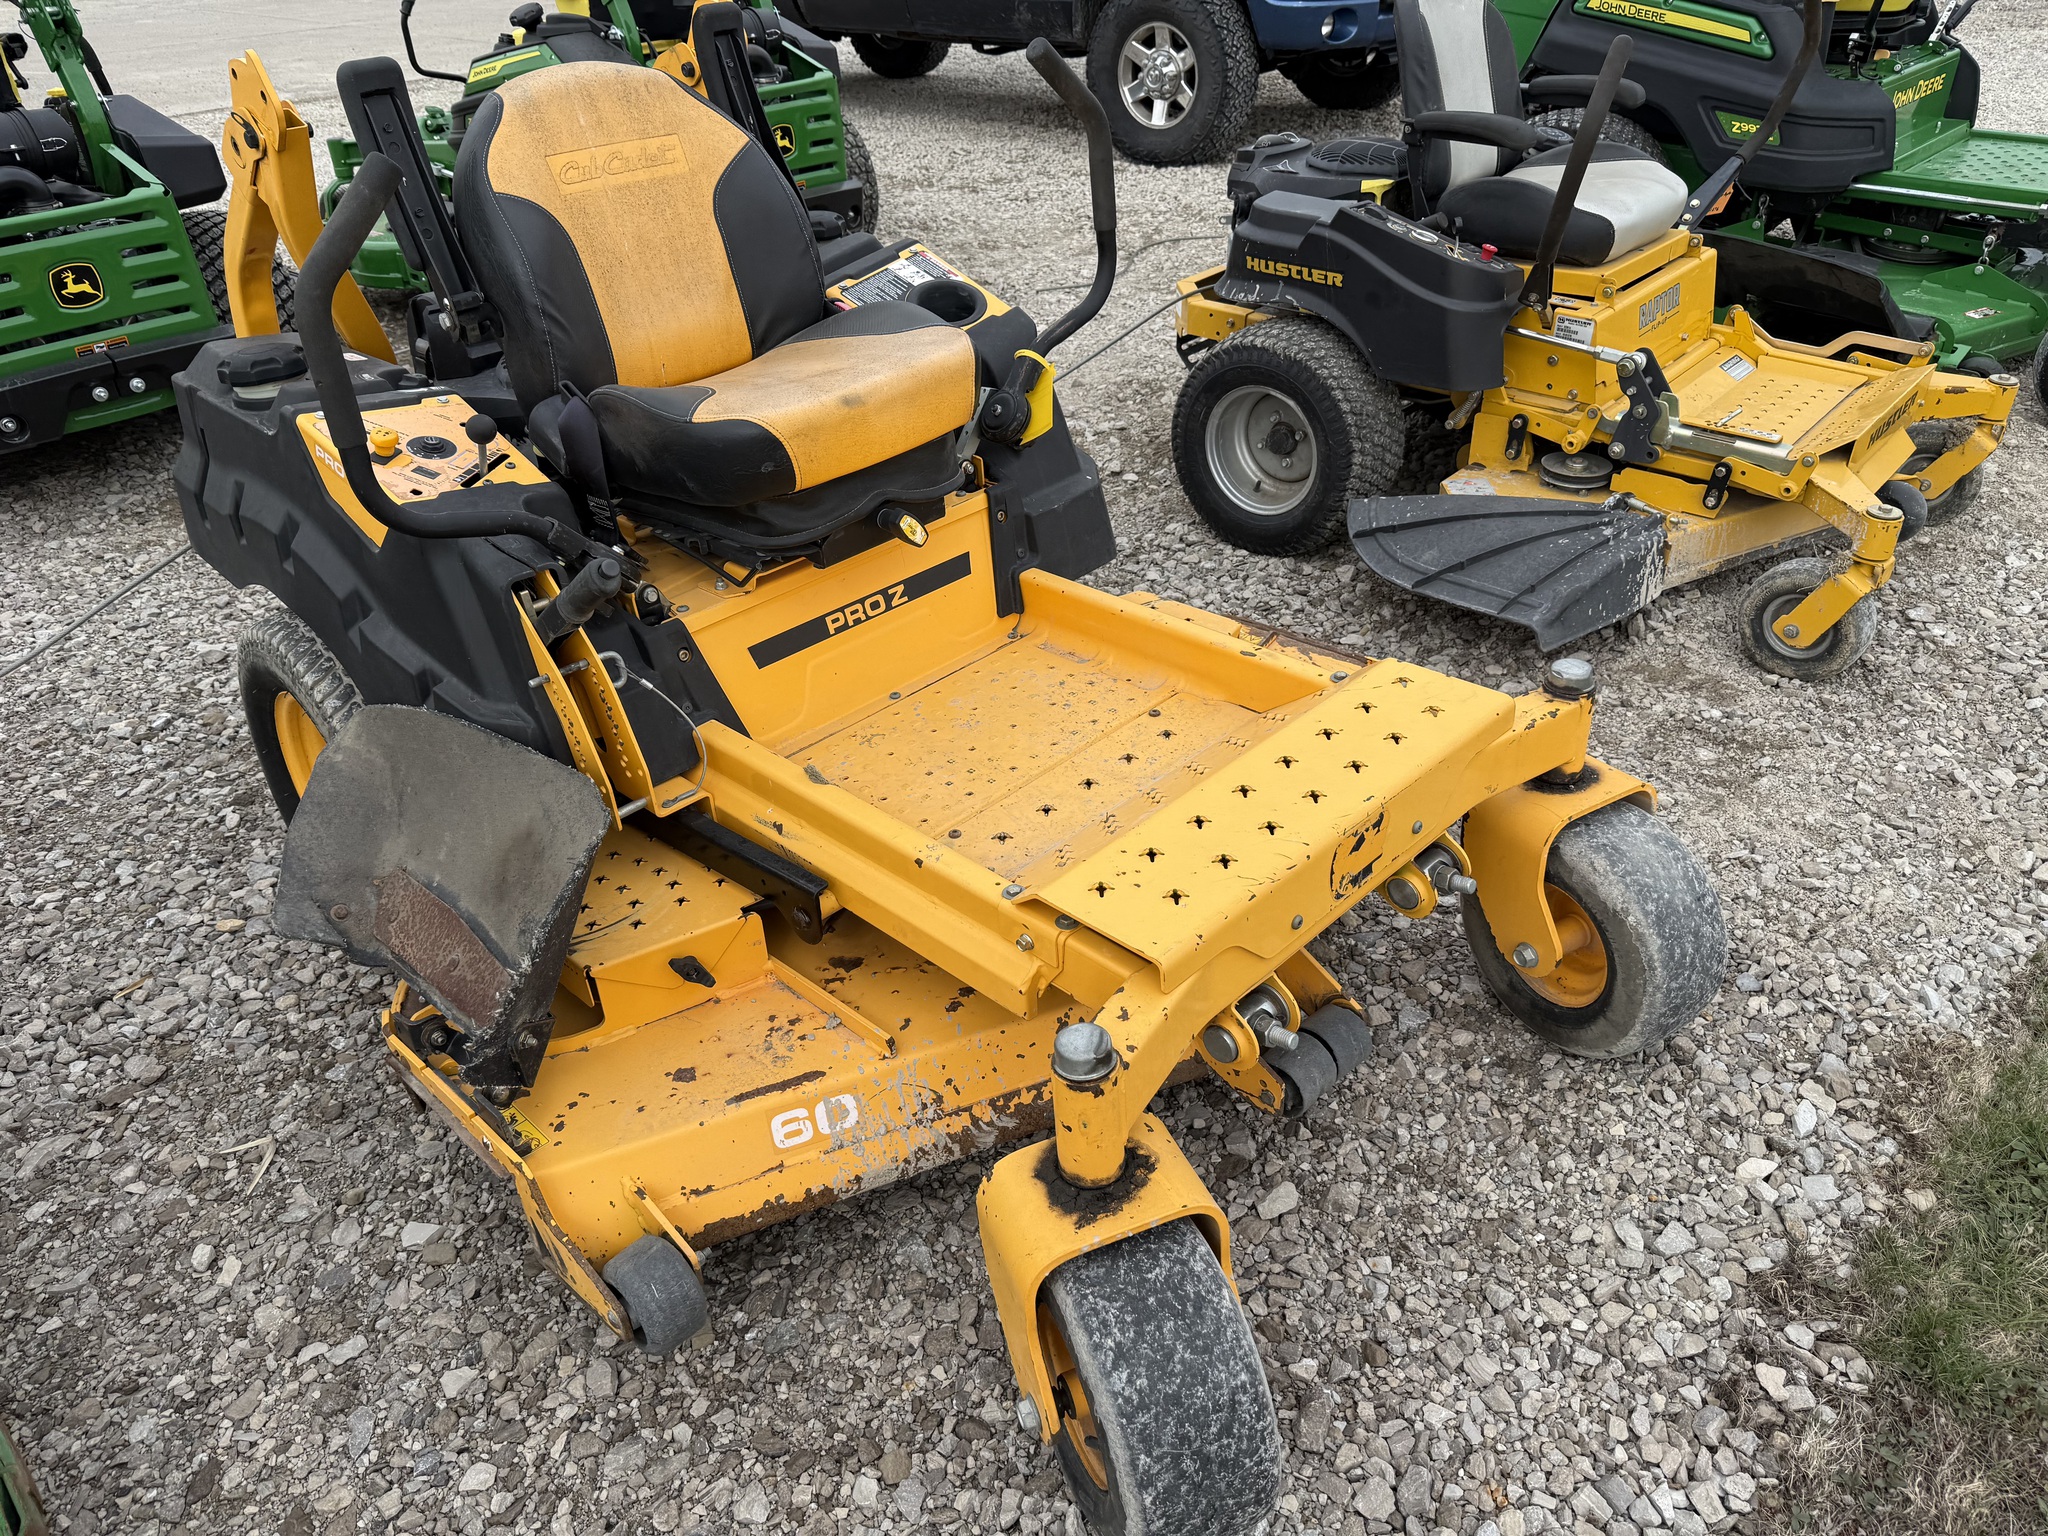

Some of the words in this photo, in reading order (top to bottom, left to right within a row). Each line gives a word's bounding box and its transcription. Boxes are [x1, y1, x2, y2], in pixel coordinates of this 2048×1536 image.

[1595, 0, 1626, 14] JOHN
[1629, 4, 1667, 22] DEERE
[472, 69, 483, 78] JOHN
[483, 65, 497, 75] DEERE
[1892, 86, 1916, 110] JOHN
[1914, 73, 1947, 100] DEERE
[559, 155, 604, 185] Cub
[603, 144, 676, 175] Cadet
[1246, 255, 1343, 287] HUSTLER
[1639, 282, 1680, 331] RAPTOR
[1866, 390, 1919, 450] HUSTLER
[315, 444, 345, 478] PRO
[825, 593, 886, 635] PRO
[887, 583, 909, 608] Z
[770, 1093, 859, 1149] 60
